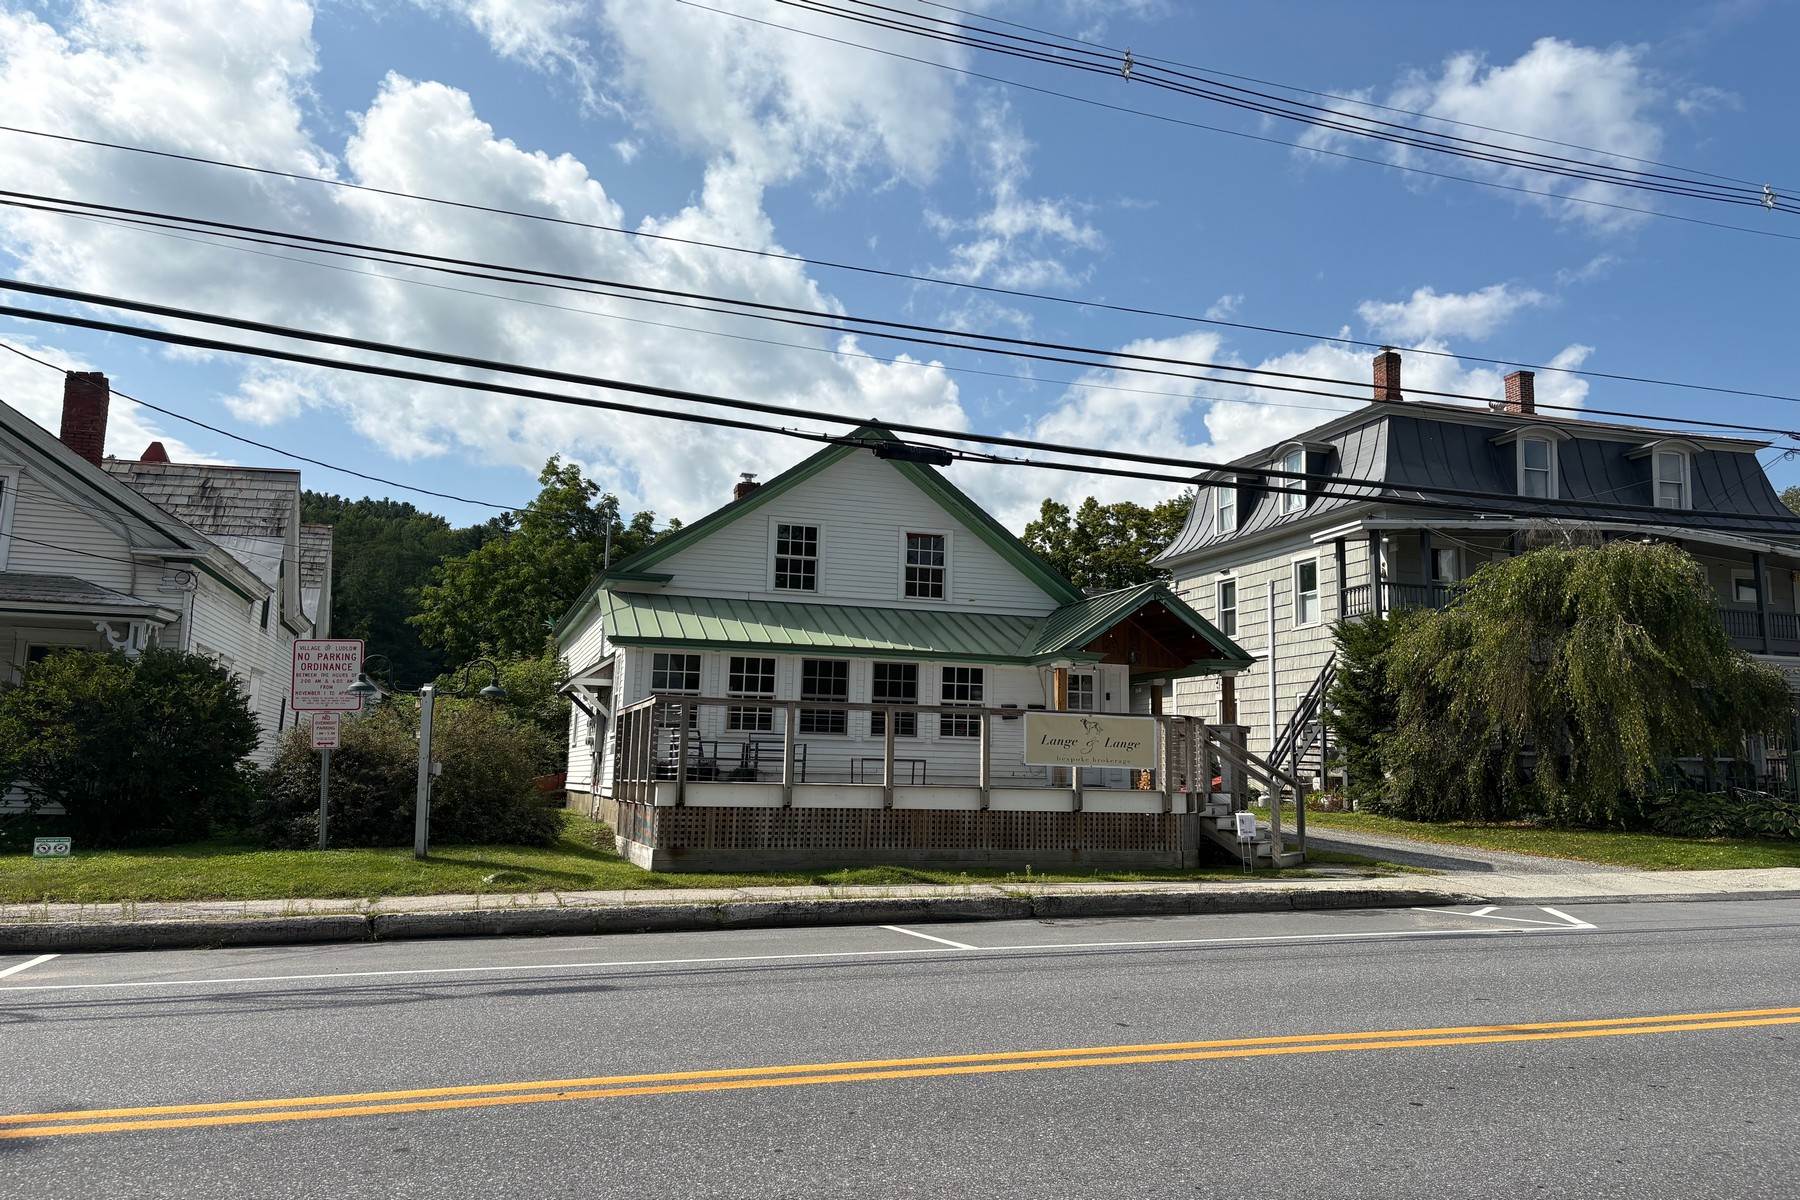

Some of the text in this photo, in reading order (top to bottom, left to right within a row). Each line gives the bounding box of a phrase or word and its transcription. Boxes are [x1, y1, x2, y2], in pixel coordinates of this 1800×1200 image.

[1041, 734, 1140, 754] Lange & Lange
